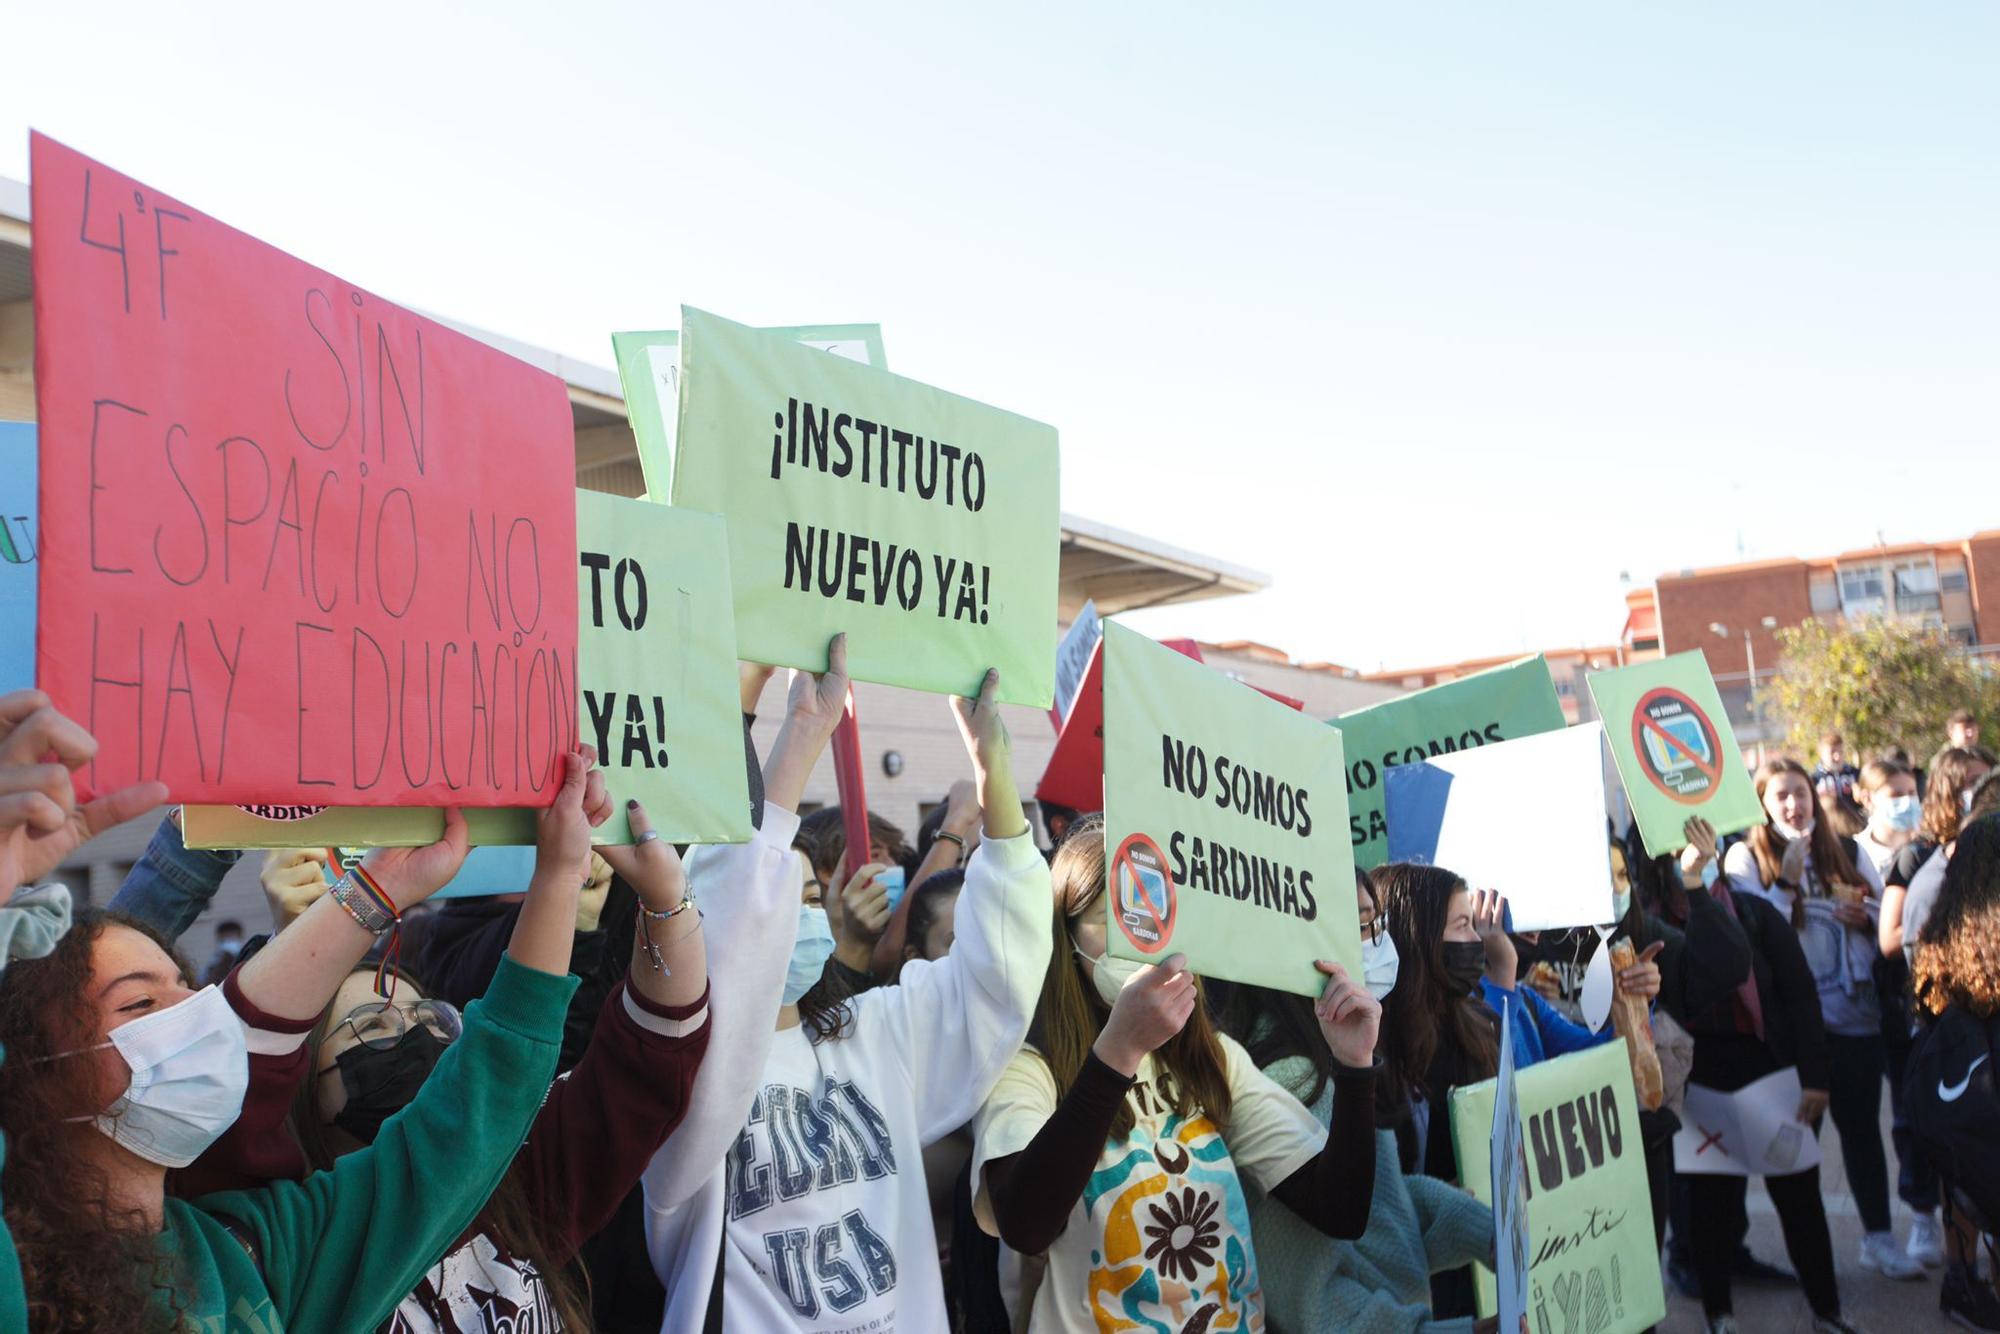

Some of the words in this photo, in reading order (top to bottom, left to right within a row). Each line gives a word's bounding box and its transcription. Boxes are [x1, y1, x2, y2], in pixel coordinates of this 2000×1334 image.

[771, 398, 986, 513] ¡INSTITUTO
[466, 508, 542, 635] NO
[581, 552, 648, 631] TO
[784, 522, 923, 612] NUEVO
[934, 555, 990, 625] YA!
[90, 612, 245, 789] HAY
[583, 690, 669, 769] YA!
[1162, 734, 1208, 799] NO
[1215, 756, 1312, 838] SOMOS
[1169, 831, 1317, 921] SARDINAS
[763, 1208, 897, 1320] USA
[1528, 1206, 1628, 1273] insti
